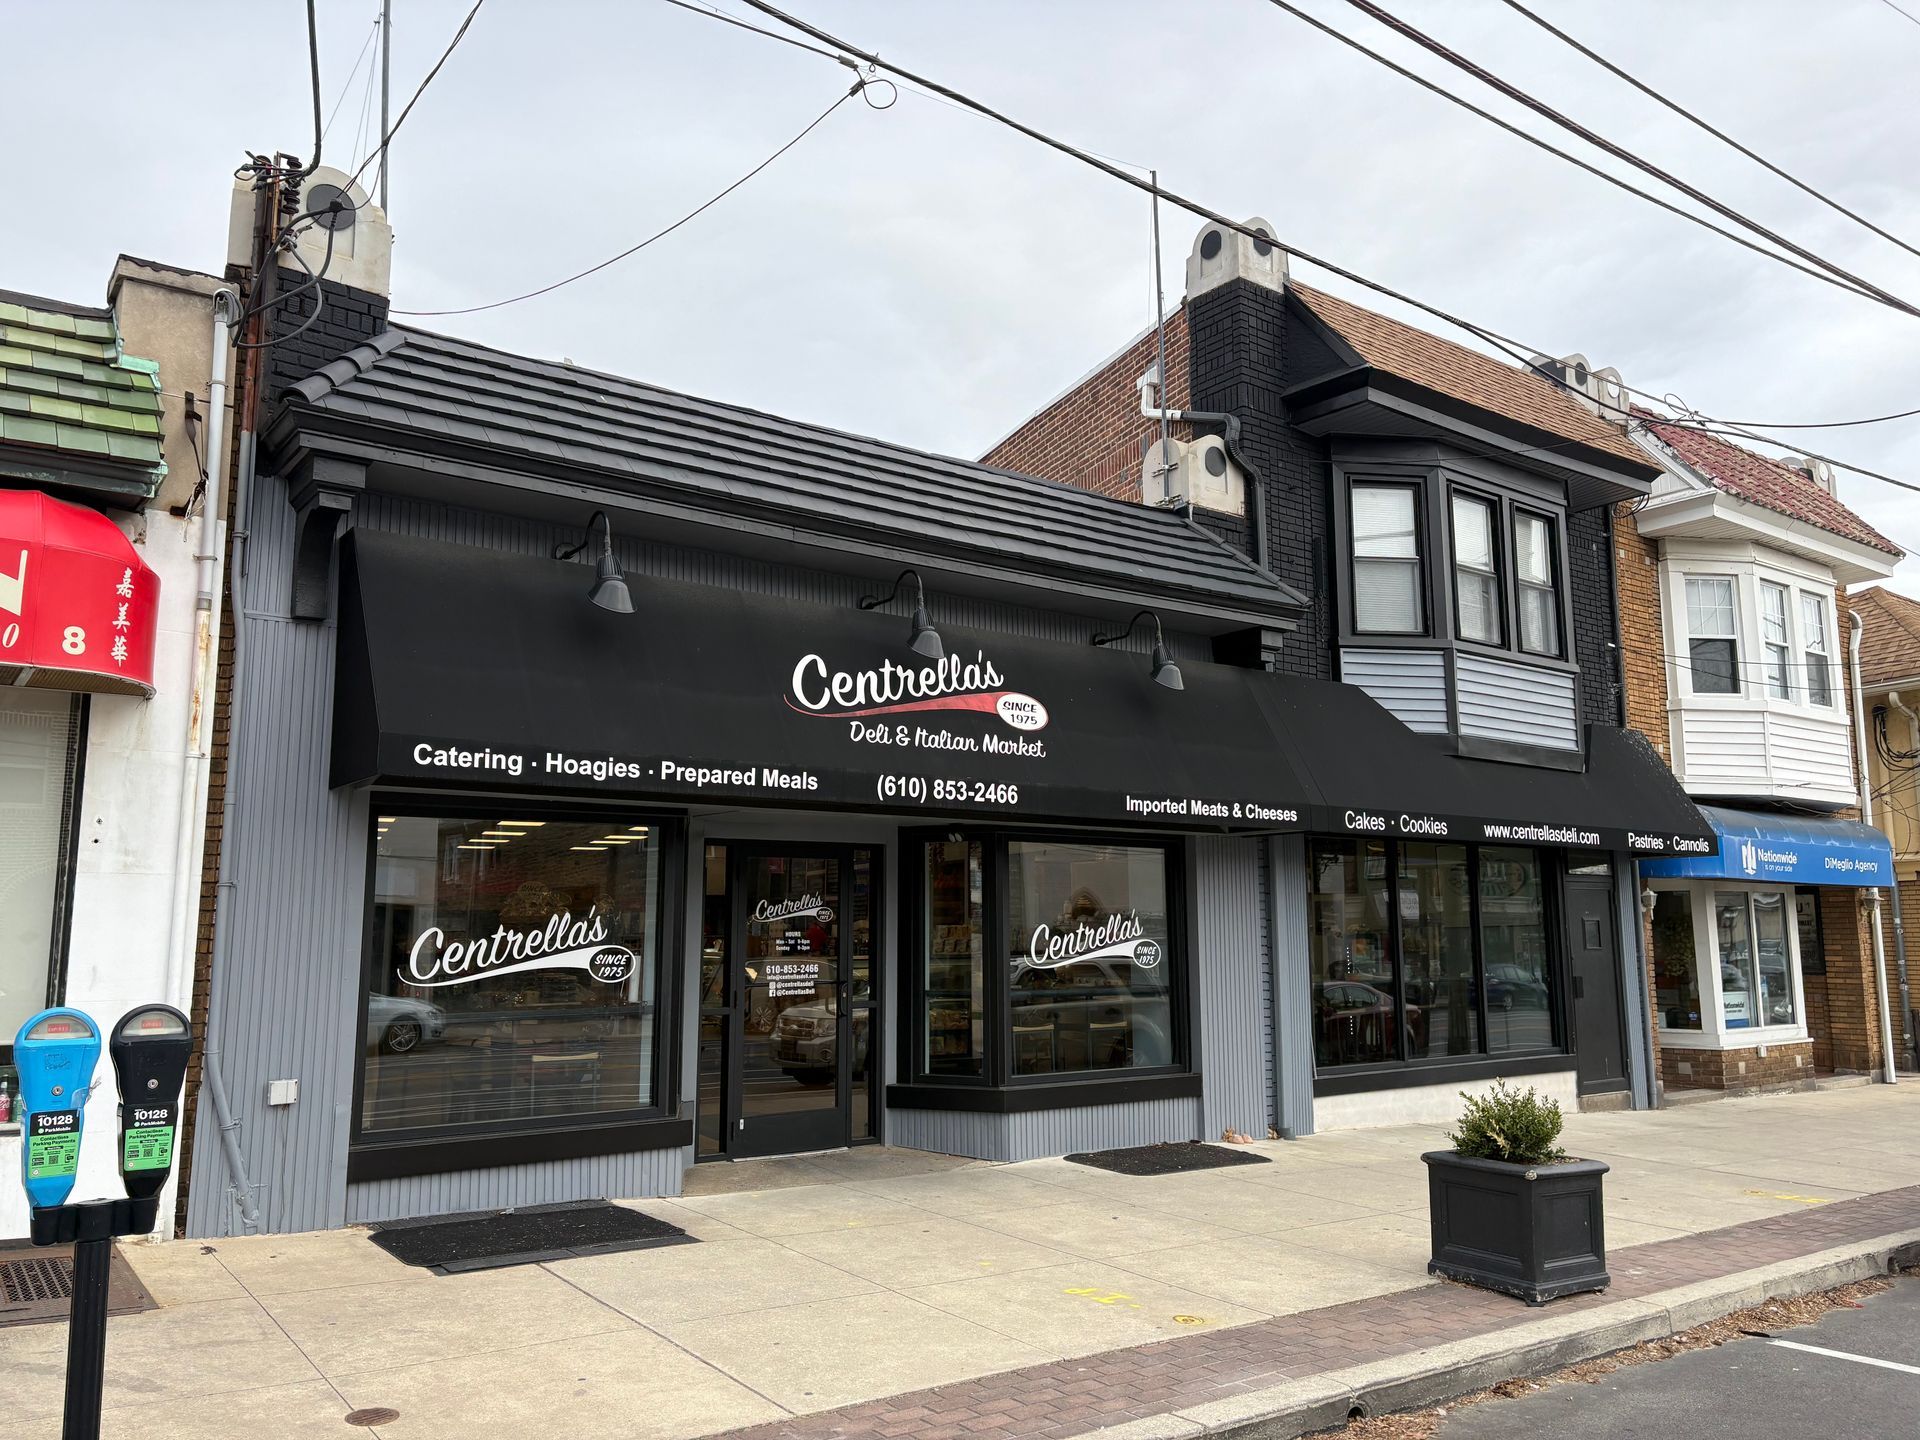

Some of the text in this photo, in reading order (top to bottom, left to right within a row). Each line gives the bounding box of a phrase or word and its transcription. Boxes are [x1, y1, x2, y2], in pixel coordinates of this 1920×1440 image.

[110, 567, 135, 668] 嘉美華
[61, 625, 86, 656] 8
[791, 649, 1005, 711] Centrella's
[1002, 701, 1038, 713] SINCE
[1010, 713, 1038, 725] 1975
[849, 720, 1047, 758] Deli & Italian Market
[413, 743, 818, 791] Catering Hoagies Prepared Meals
[877, 774, 1019, 805] (610) 853-2466
[1125, 795, 1298, 823] Imported Meats & Cheeses
[1344, 810, 1448, 836] Cakes Cookies
[1483, 824, 1600, 846] www.centrellasdeli.com
[1627, 832, 1710, 853] Pastries Cannolis
[1757, 848, 1797, 865] Nationwide
[1824, 857, 1878, 874] DiMeglio Agency
[1775, 865, 1784, 873] your
[755, 890, 824, 920] Centrella's
[409, 904, 608, 980] Centrella's
[1030, 907, 1144, 964] Centrella's
[594, 954, 627, 965] SINCE
[1136, 945, 1157, 955] SINCE
[1138, 955, 1155, 964] 1975
[598, 966, 623, 977] 1975
[766, 964, 819, 974] 610-853-2466
[38, 1115, 73, 1127] 10128
[134, 1109, 168, 1120] 10128
